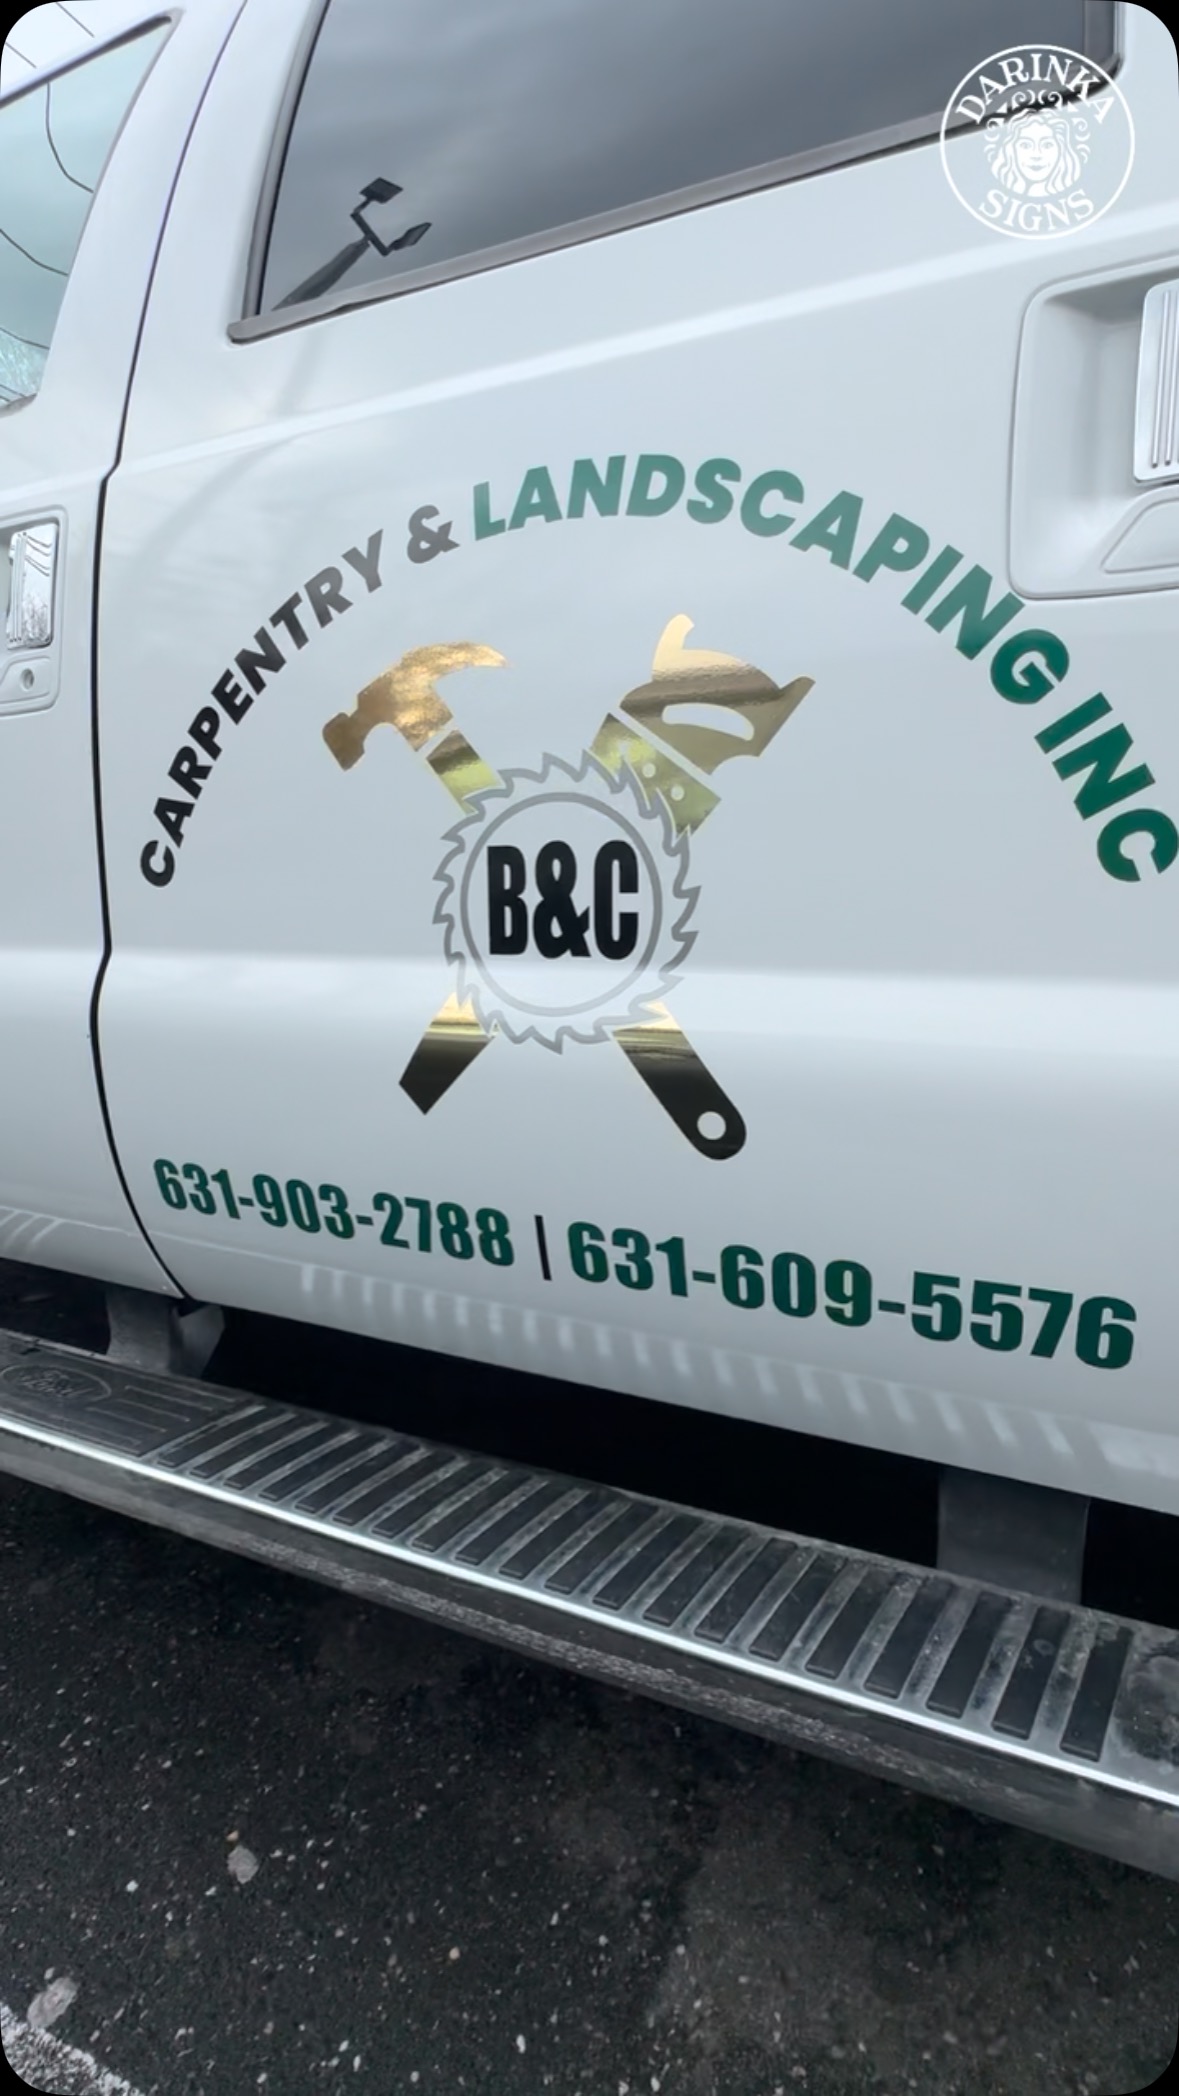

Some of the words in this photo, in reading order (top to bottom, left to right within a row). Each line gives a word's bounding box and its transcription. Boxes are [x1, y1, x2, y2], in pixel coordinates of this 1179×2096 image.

[140, 529, 383, 887] CARPENTRY
[406, 505, 460, 564] &
[473, 454, 1070, 705] LANDSCAPING
[1034, 692, 1179, 882] INC
[487, 840, 639, 960] B&C
[153, 1158, 514, 1266] 631-903-2788
[567, 1221, 1137, 1370] 631-609-5576
